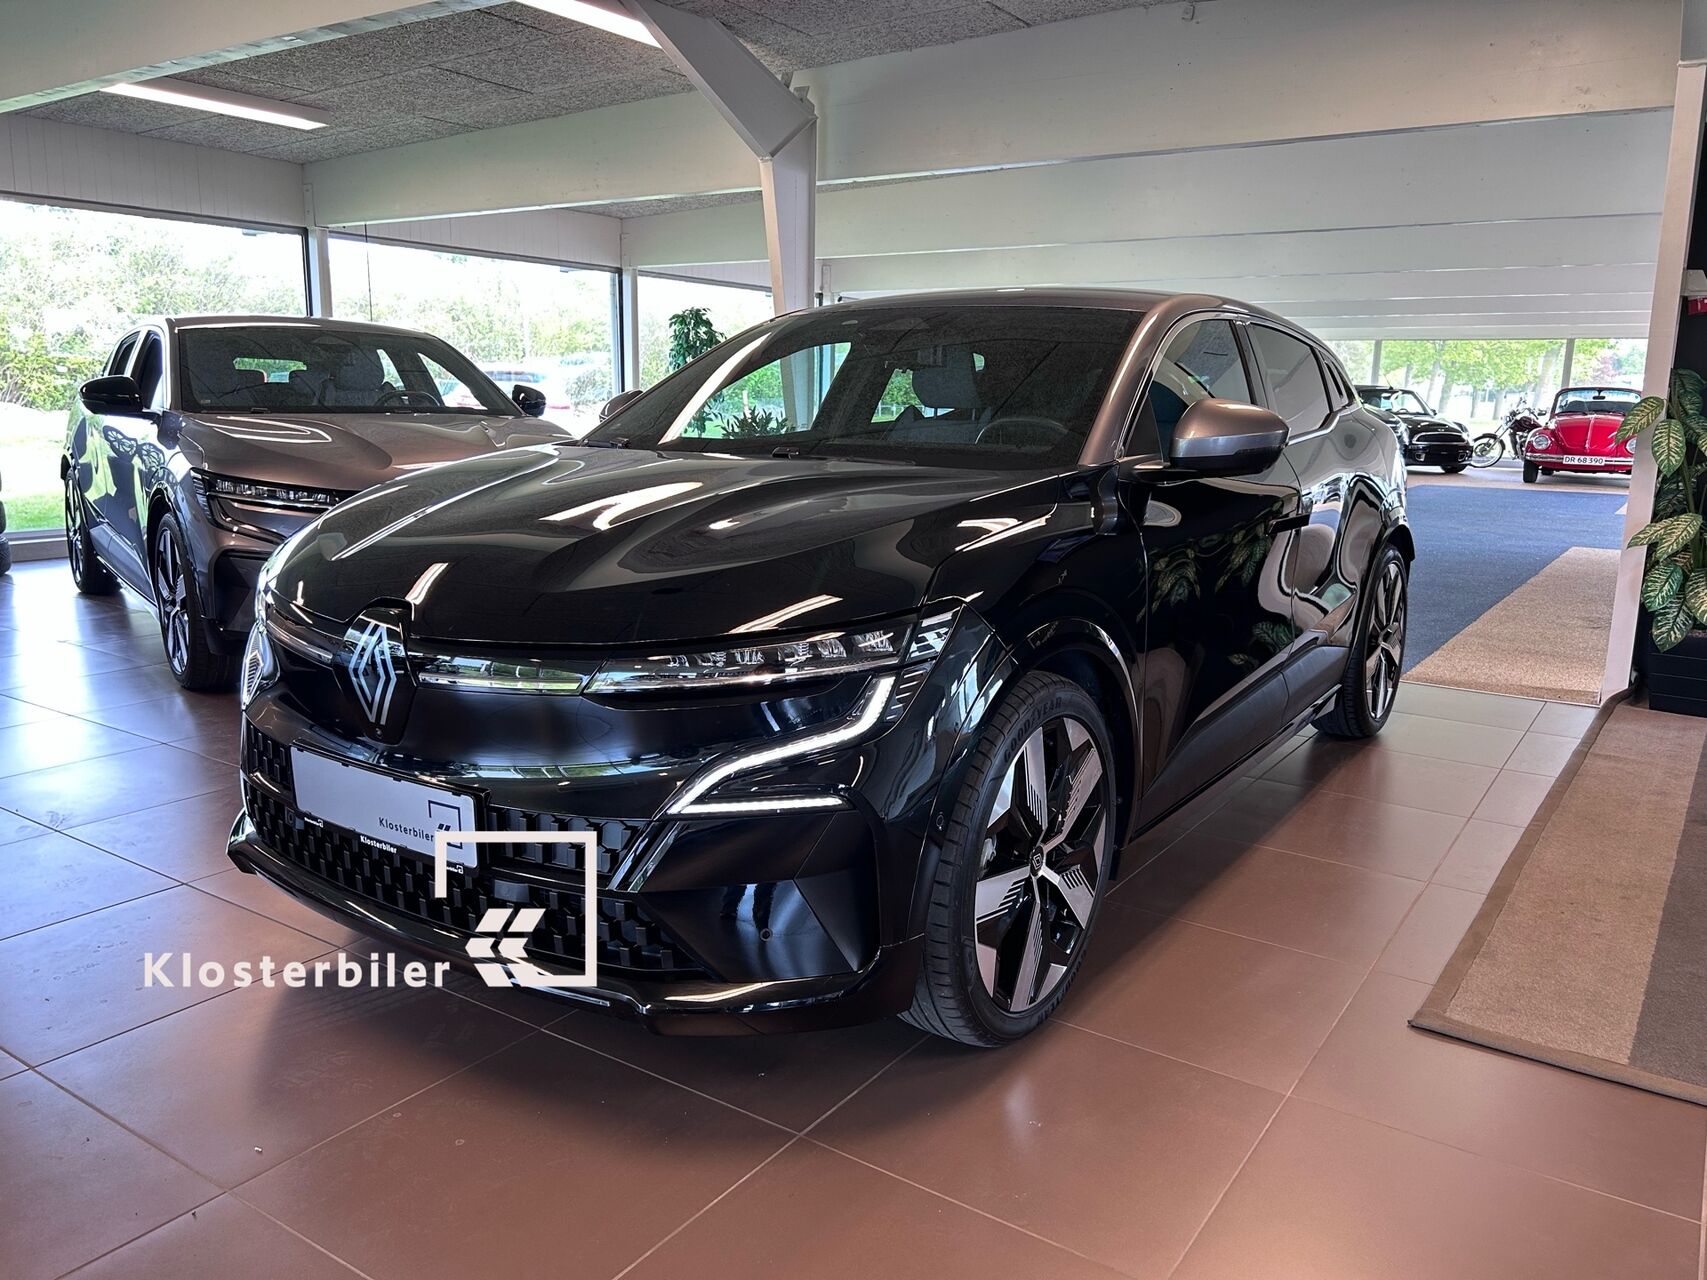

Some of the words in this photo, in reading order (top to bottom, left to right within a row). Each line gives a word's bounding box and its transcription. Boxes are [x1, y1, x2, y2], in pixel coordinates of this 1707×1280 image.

[1004, 696, 1063, 763] GOODYEAR
[378, 816, 434, 842] Klosterbiler
[360, 835, 398, 854] Klosterbiler
